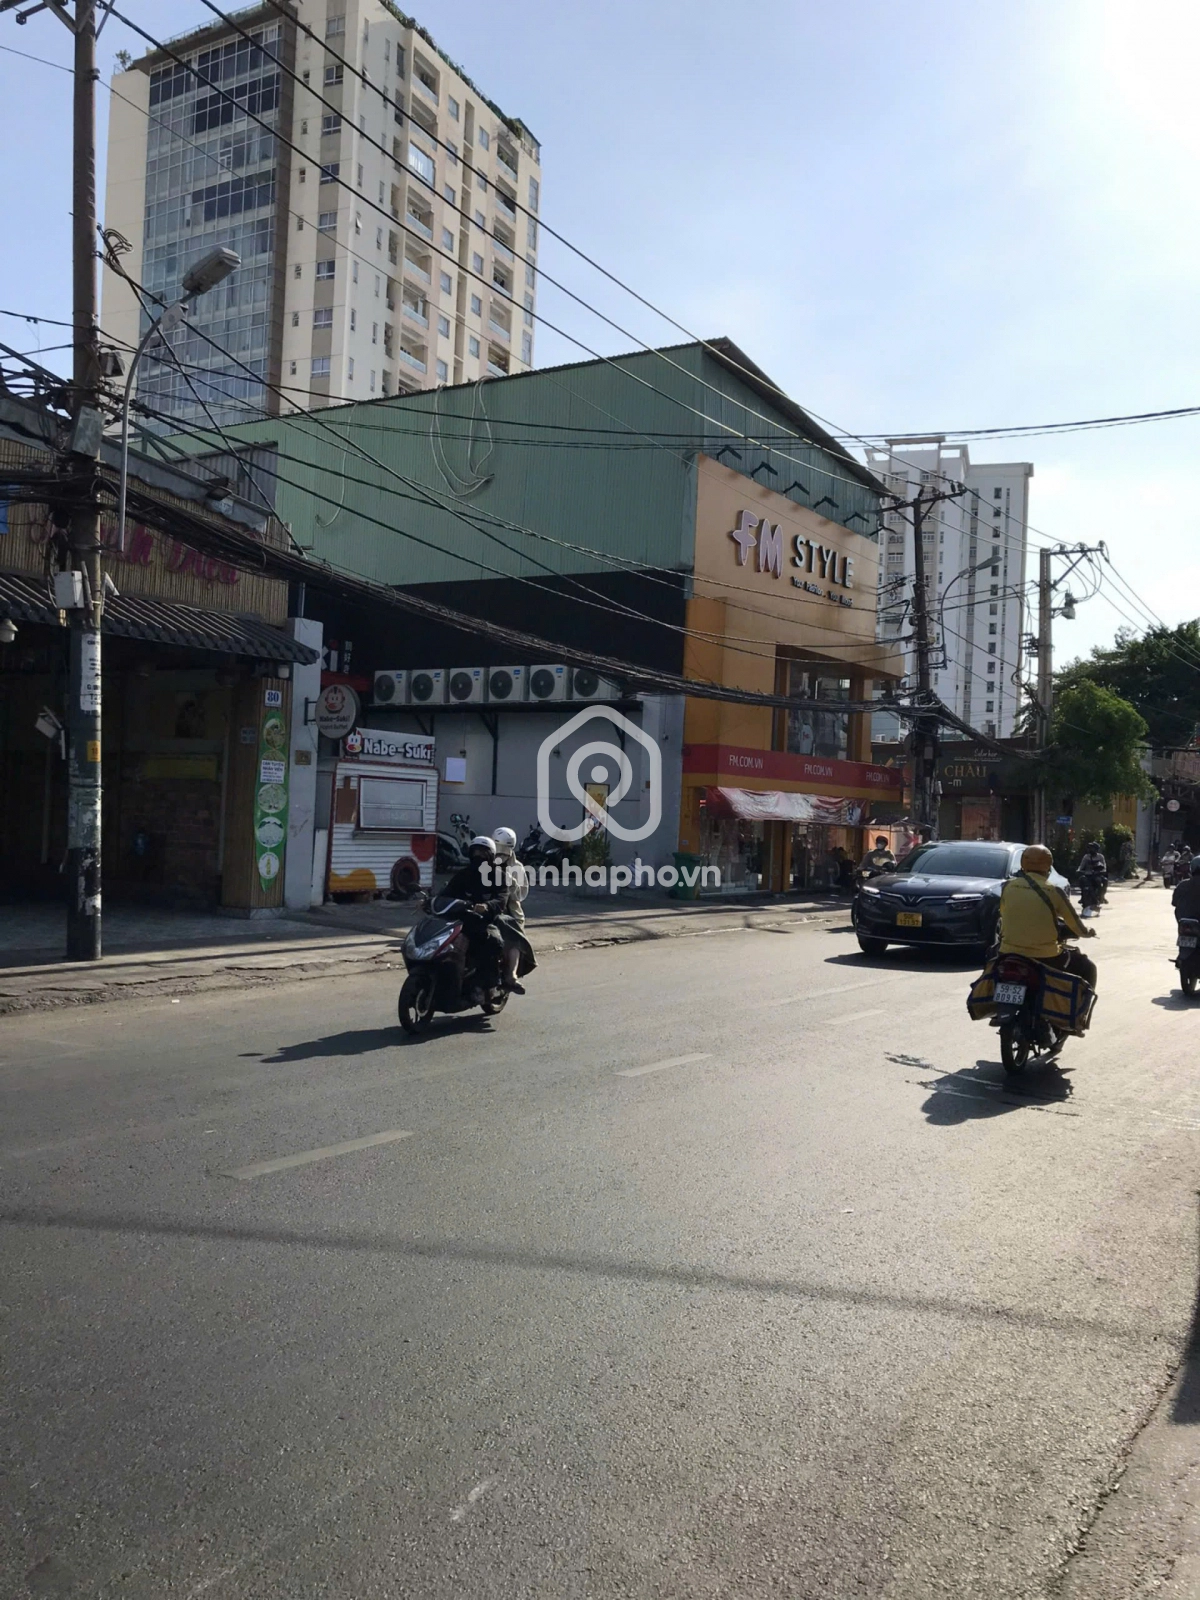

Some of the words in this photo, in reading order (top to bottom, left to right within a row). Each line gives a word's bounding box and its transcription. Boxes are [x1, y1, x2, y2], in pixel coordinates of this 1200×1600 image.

[729, 509, 784, 579] FM
[790, 533, 856, 589] STYLE
[267, 691, 279, 702] 80
[364, 738, 432, 760] Nabe-Suki
[729, 754, 764, 769] FM.COM.VN
[804, 763, 834, 778] FM.COM.VN
[944, 763, 988, 778] CHÂU
[1000, 984, 1022, 995] 59-S2
[996, 992, 1023, 1004] 809.65
